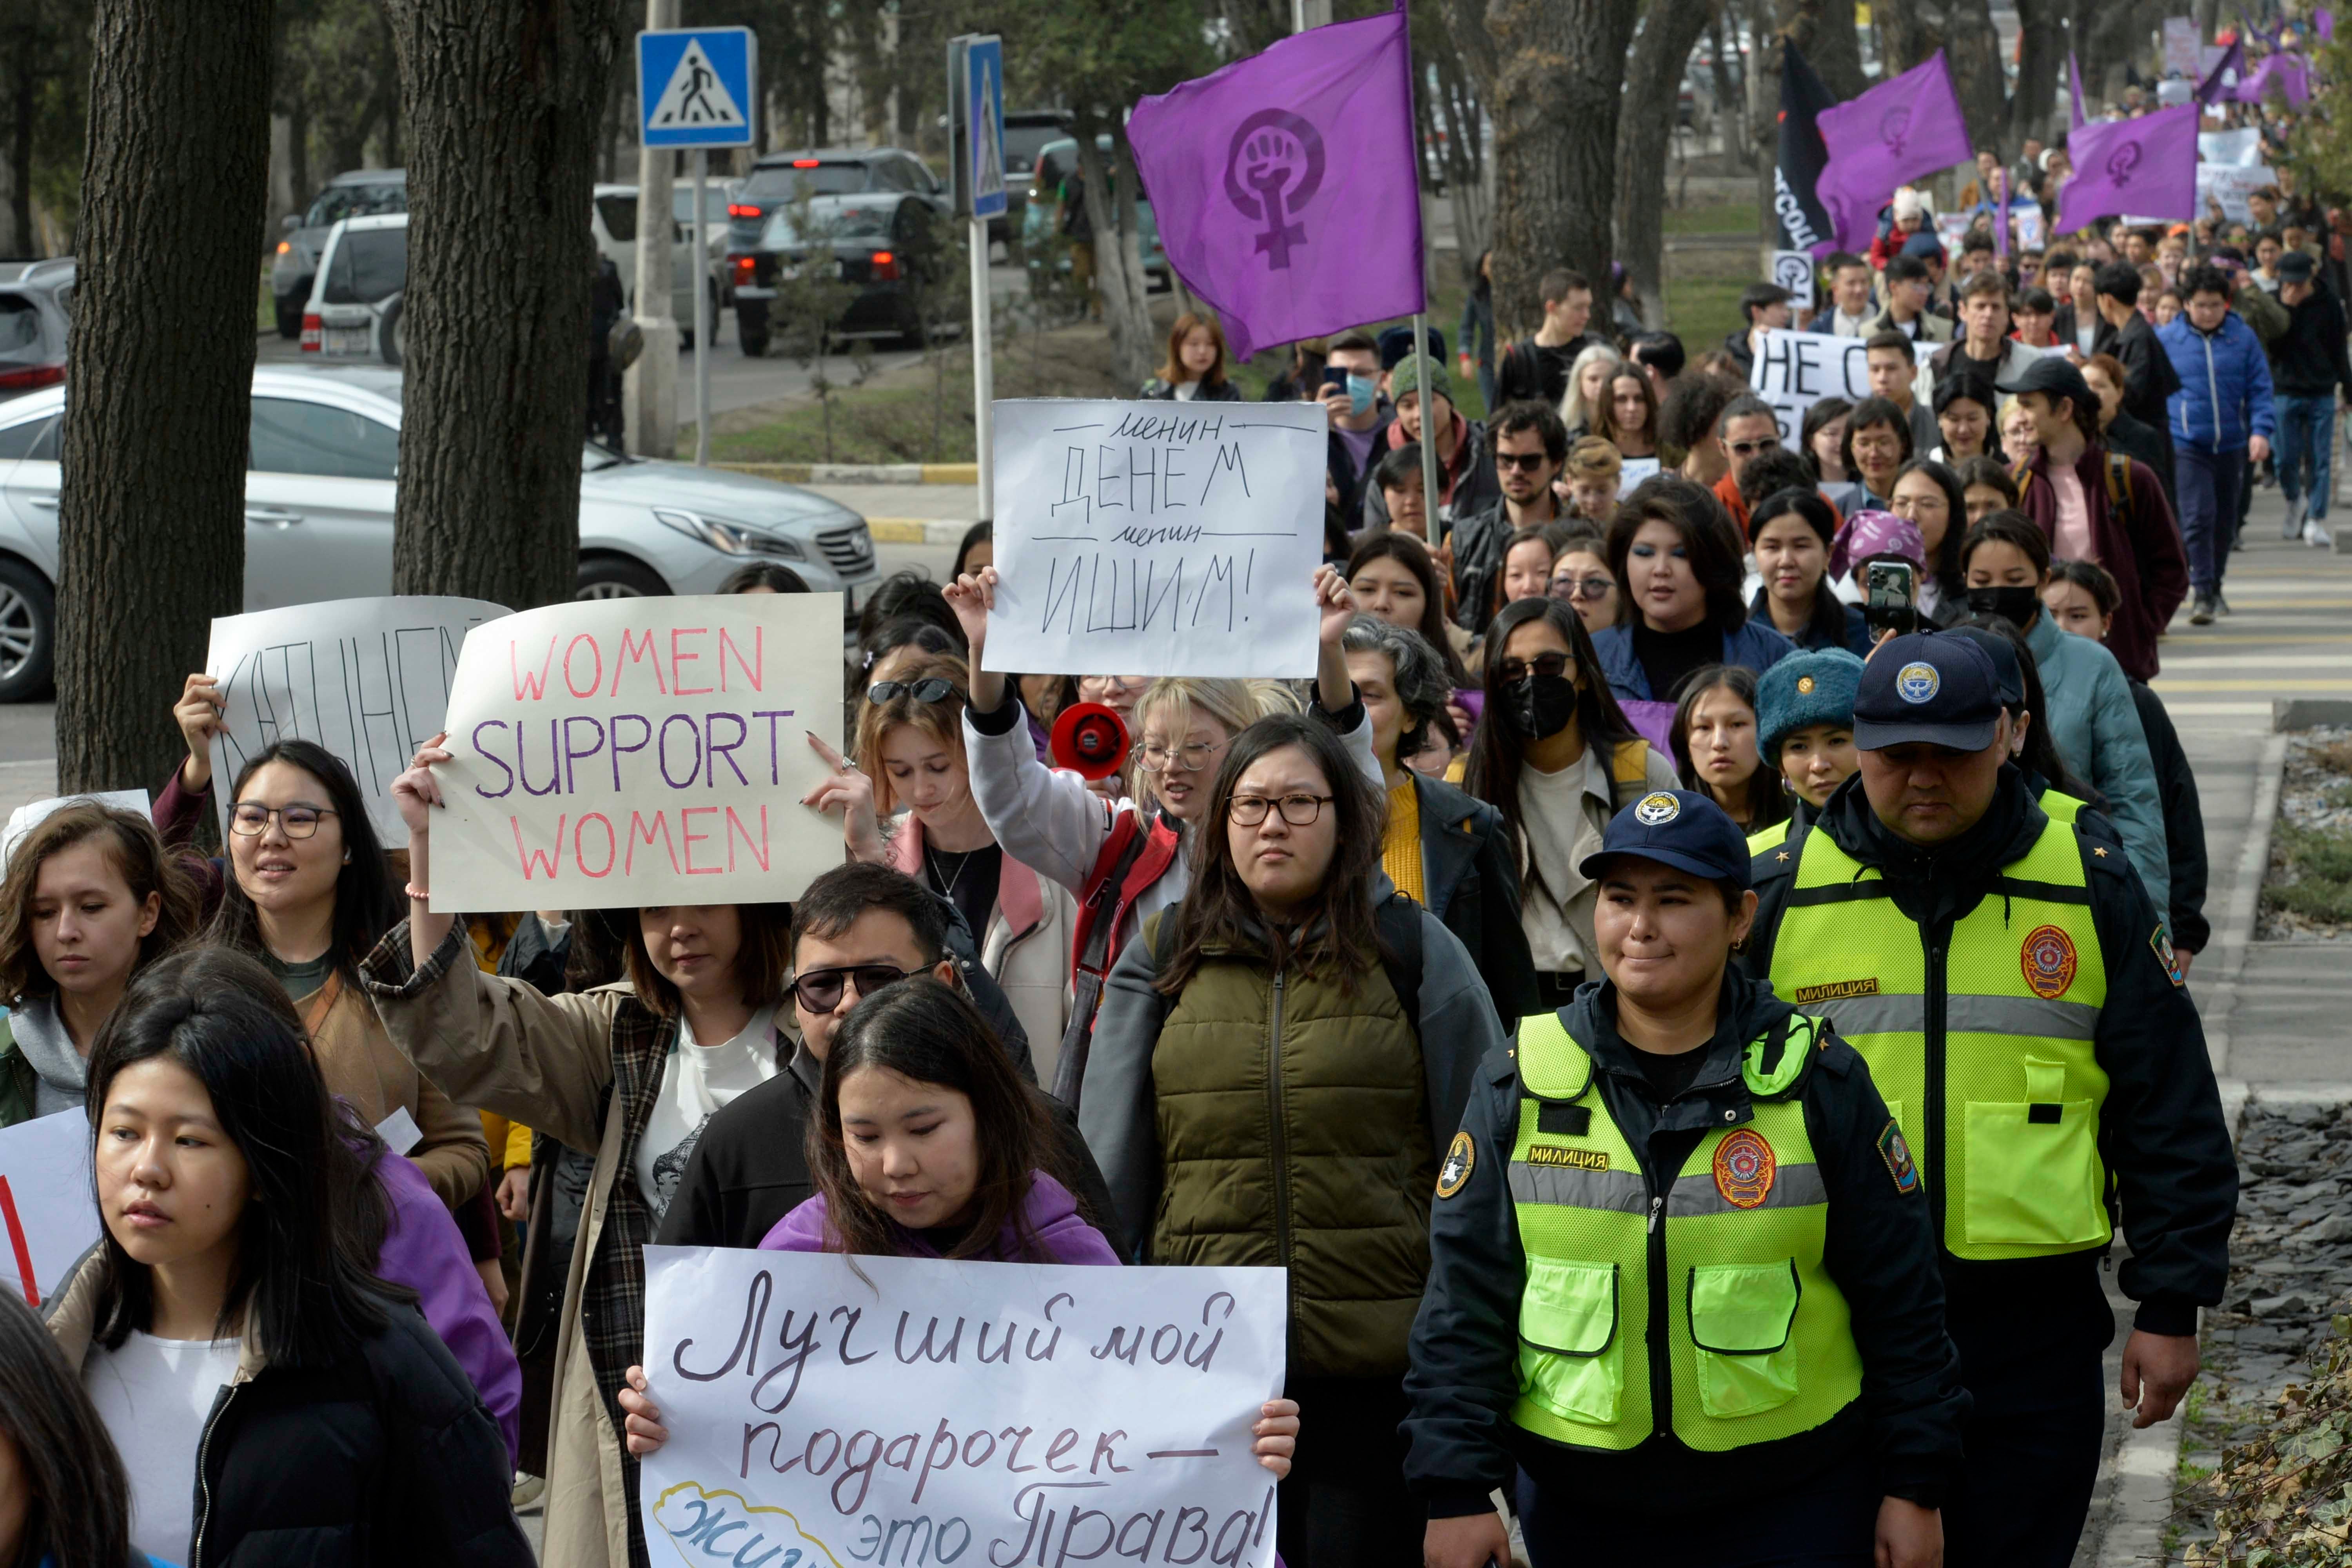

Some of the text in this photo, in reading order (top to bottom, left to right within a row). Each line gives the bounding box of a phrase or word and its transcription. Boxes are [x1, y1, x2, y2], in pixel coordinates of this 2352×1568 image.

[1110, 413, 1222, 442] менин
[1052, 442, 1250, 523] ДЕНЕМ
[1111, 525, 1202, 546] менин
[1042, 548, 1254, 634] ИШИМ!
[511, 626, 762, 701] WOMEN
[472, 710, 794, 798] SUPPORT
[510, 805, 769, 880] WOMEN
[1798, 980, 1875, 1001] МИЛИЦИЯ
[1530, 1147, 1606, 1168] МИЛИЦИЯ
[673, 1270, 1235, 1414] Лучший мой
[740, 1418, 1131, 1515] подарочек
[847, 1481, 1275, 1568] это Права!
